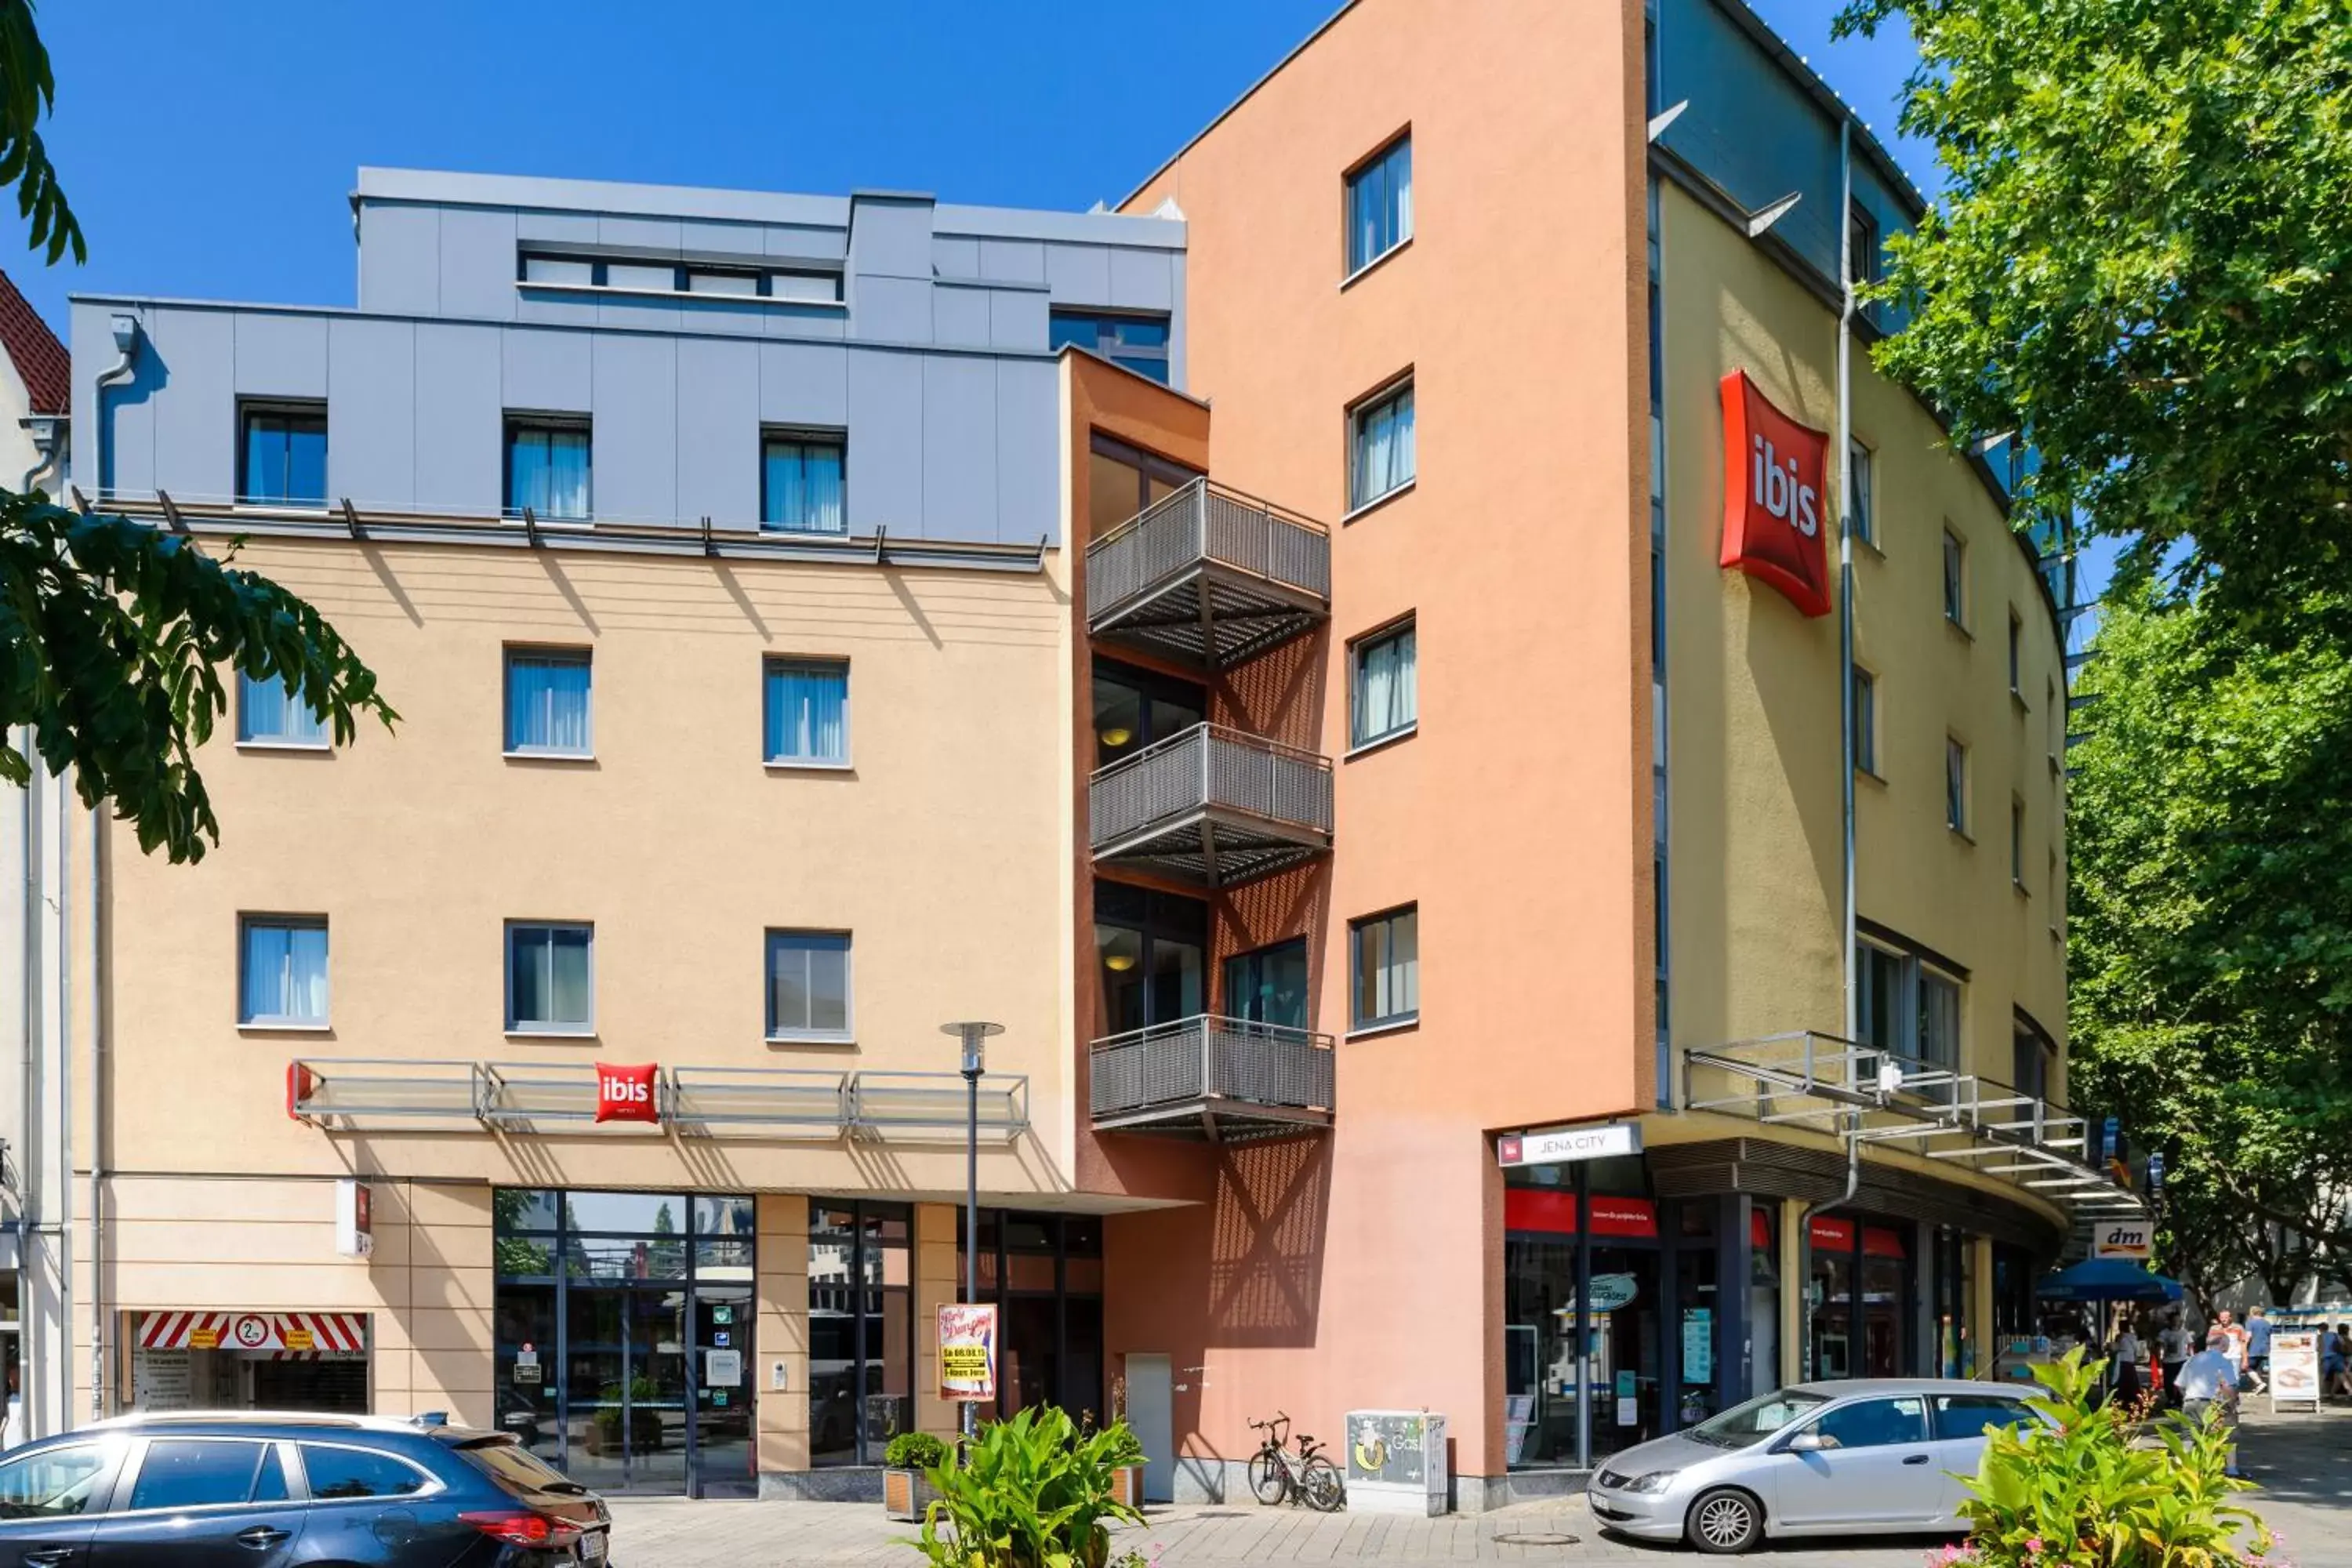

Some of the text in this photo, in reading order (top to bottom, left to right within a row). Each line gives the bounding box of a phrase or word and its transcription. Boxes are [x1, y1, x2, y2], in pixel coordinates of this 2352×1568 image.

[1755, 433, 1817, 537] ibis
[603, 1076, 648, 1102] ibis
[1541, 1134, 1606, 1154] JENA CITY
[2107, 1228, 2143, 1244] dm
